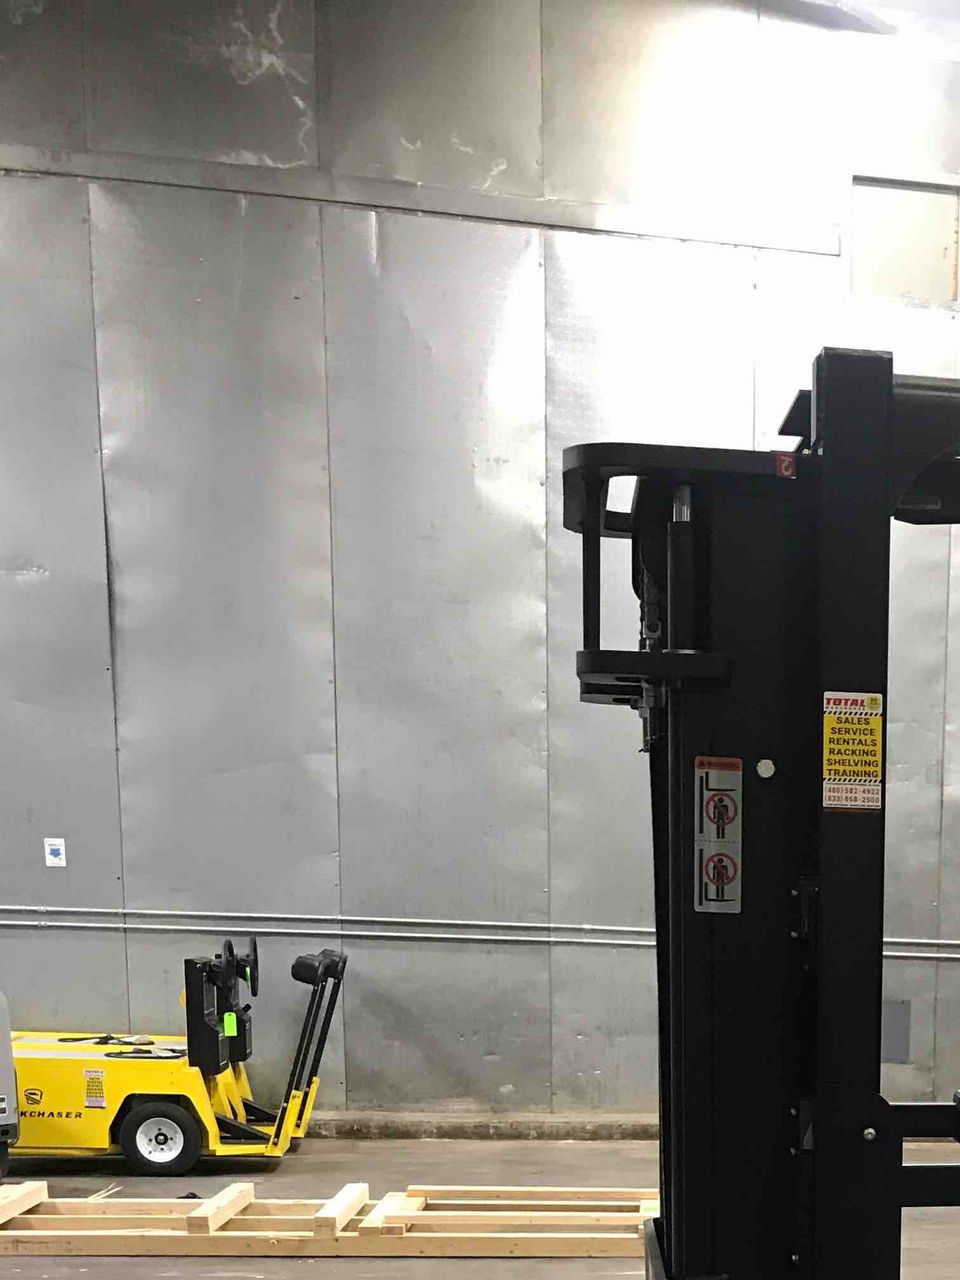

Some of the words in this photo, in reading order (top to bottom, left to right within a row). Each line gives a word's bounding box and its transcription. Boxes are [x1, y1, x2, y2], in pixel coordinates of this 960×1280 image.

[825, 697, 866, 707] TOTAL
[836, 716, 870, 725] SALES
[830, 727, 876, 736] SERVICE
[828, 737, 877, 747] RENTALS
[828, 747, 877, 757] RACKING
[826, 758, 879, 768] SHELVING
[826, 768, 878, 778] TRAINING
[20, 1110, 83, 1119] KCHASER
